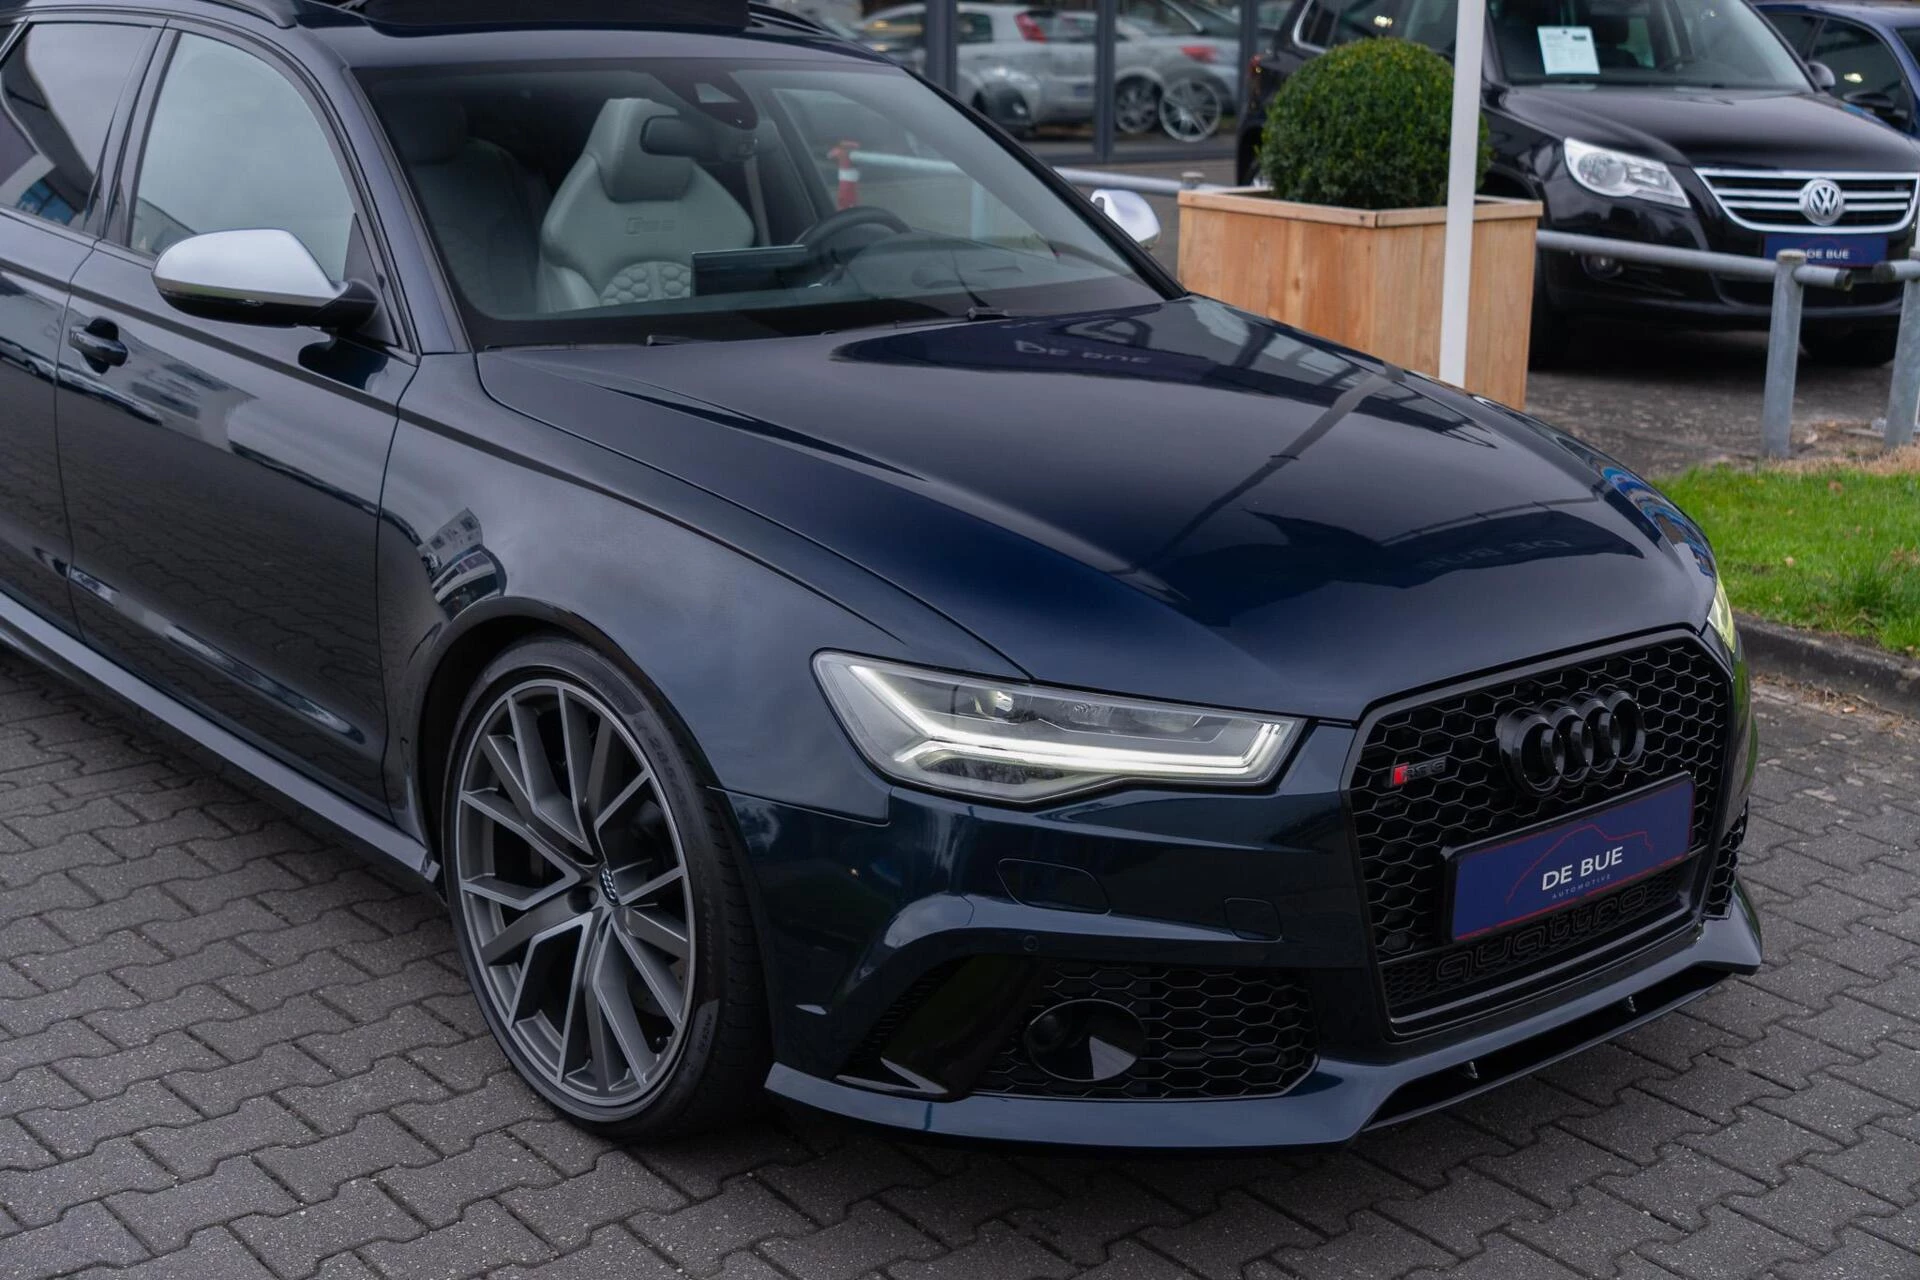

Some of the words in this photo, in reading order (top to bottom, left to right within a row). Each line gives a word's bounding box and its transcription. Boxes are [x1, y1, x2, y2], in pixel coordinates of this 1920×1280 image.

[1807, 248, 1823, 259] DE
[1826, 248, 1849, 259] BUE
[1541, 864, 1573, 891] DE
[1580, 846, 1624, 877] BUE
[1552, 873, 1611, 900] AUTOMOTIVE
[1435, 884, 1648, 982] quattro
